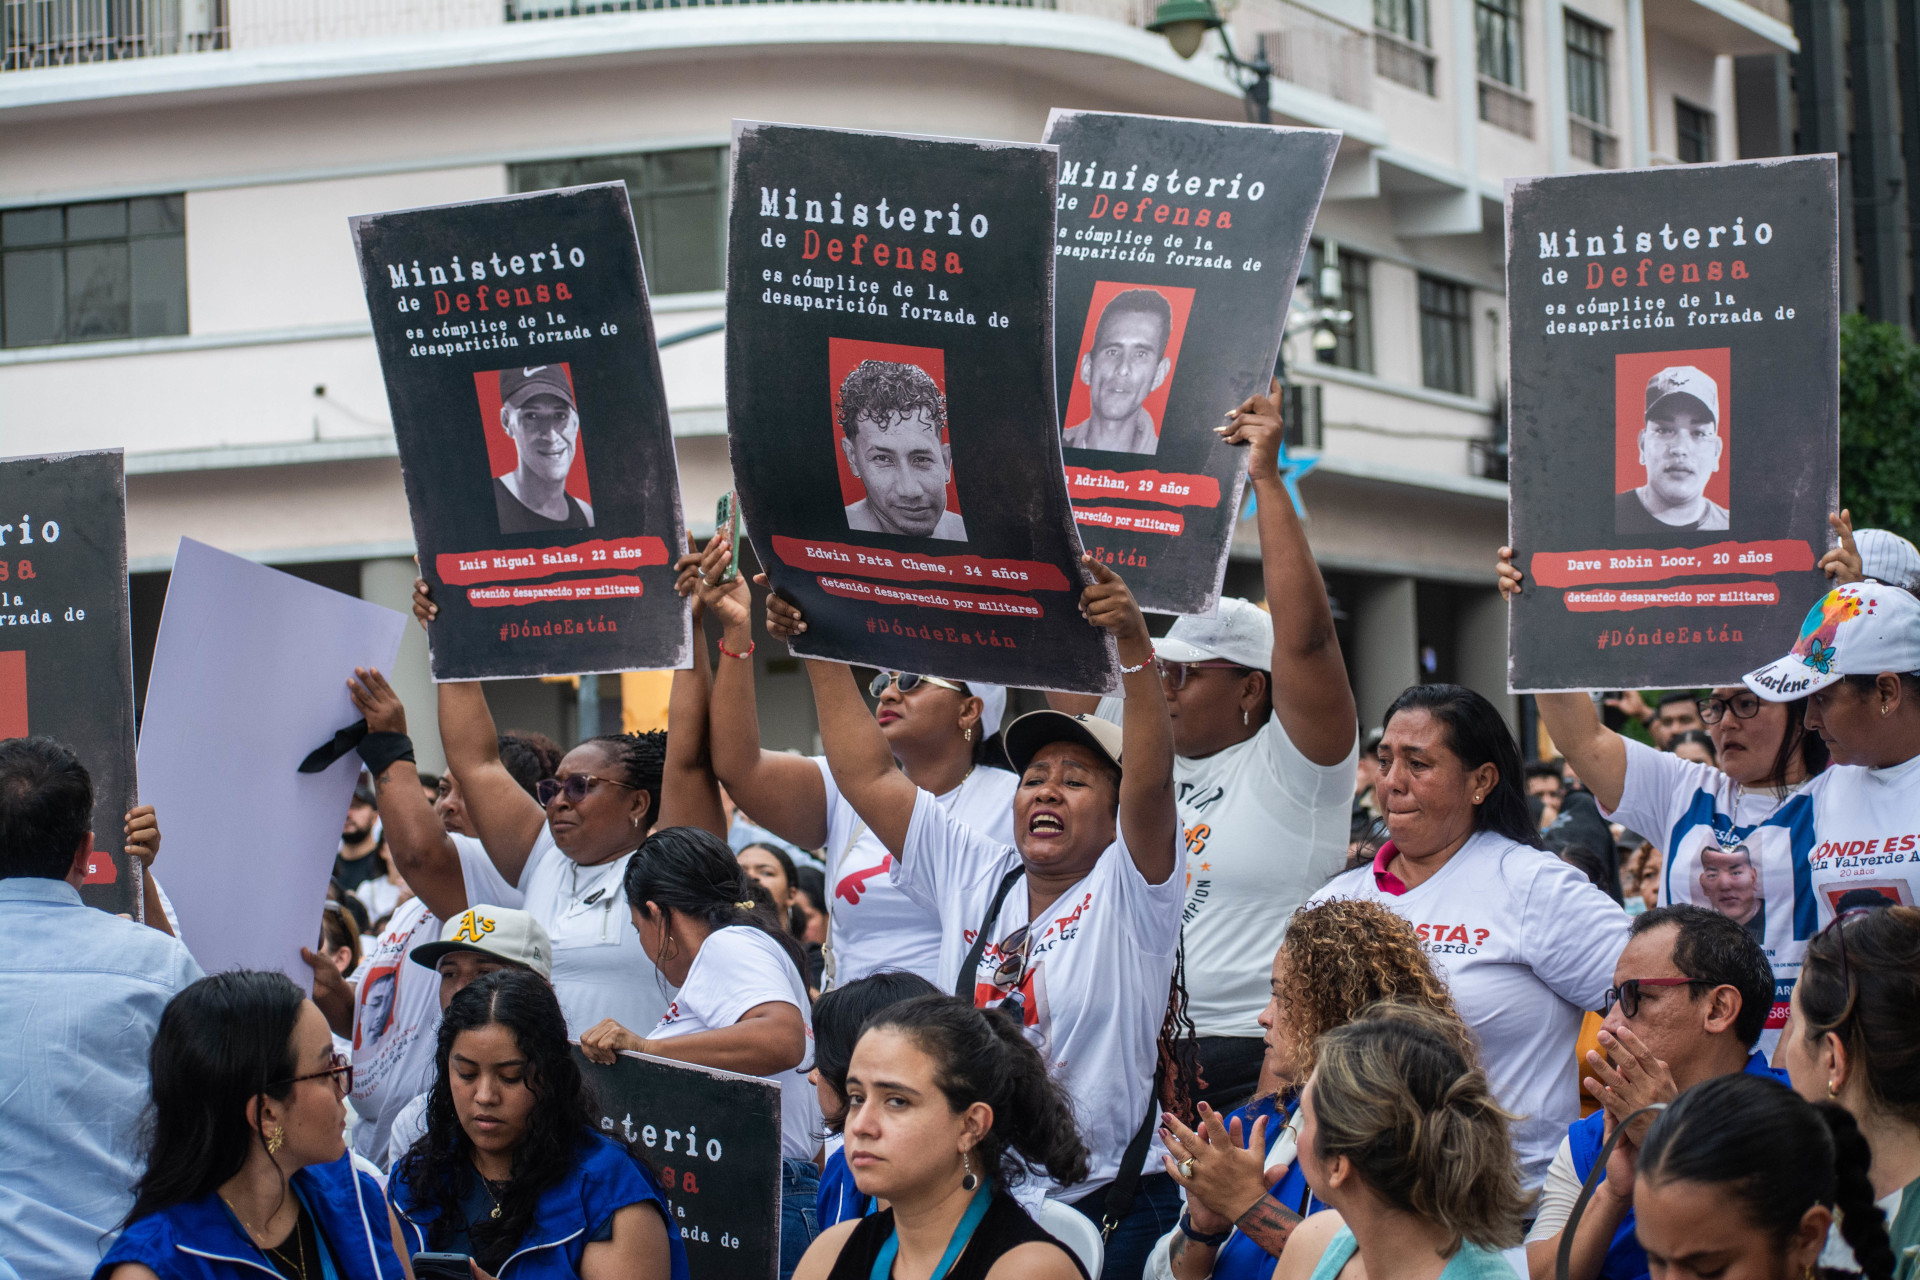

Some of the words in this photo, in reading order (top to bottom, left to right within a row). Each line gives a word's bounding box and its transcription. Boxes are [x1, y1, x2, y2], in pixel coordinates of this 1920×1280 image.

[1059, 160, 1265, 201] Ministerio
[760, 186, 988, 238] Ministerio
[1057, 193, 1078, 210] de
[1089, 194, 1233, 229] Defensa
[761, 228, 786, 248] de
[801, 230, 964, 274] Defensa
[1057, 226, 1067, 237] s
[1075, 225, 1153, 246] cómplice
[1164, 234, 1183, 248] de
[1194, 237, 1213, 251] la
[1539, 217, 1773, 259] Ministerio
[387, 243, 586, 289] Ministerio
[1055, 244, 1156, 263] esaparición
[1166, 252, 1233, 269] forzada
[1243, 258, 1262, 271] de
[762, 268, 783, 282] es
[792, 269, 880, 294] cómplice
[893, 281, 914, 297] de
[928, 284, 949, 301] la
[1542, 267, 1569, 285] de
[1586, 259, 1750, 290] Defensa
[397, 296, 421, 313] de
[433, 282, 573, 315] Defensa
[762, 288, 889, 316] desaparición
[901, 302, 977, 325] forzada
[988, 312, 1010, 328] de
[1545, 304, 1566, 315] es
[1576, 297, 1666, 316] cómplice
[1679, 293, 1700, 309] de
[1715, 291, 1736, 305] la
[405, 327, 424, 339] es
[432, 319, 508, 339] cómplice
[518, 315, 536, 329] de
[547, 312, 566, 325] la
[1546, 311, 1675, 335] desaparición
[1687, 308, 1763, 327] forzada
[1775, 306, 1796, 320] de
[409, 330, 519, 358] desaparición
[528, 326, 591, 345] forzada
[600, 322, 618, 336] de
[1075, 474, 1130, 492] Adrihan,
[1138, 480, 1153, 492] 29
[1160, 483, 1190, 496] años
[1074, 510, 1113, 524] parecido
[1115, 516, 1131, 527] por
[1134, 518, 1180, 533] militares
[459, 558, 487, 571] Luis
[493, 554, 536, 570] Miguel
[542, 551, 584, 565] Salas,
[592, 550, 606, 561] 22
[613, 547, 642, 560] años
[805, 547, 850, 563] Edwin
[857, 553, 894, 568] Pata
[901, 559, 953, 576] Cheme,
[964, 565, 983, 577] 34
[991, 568, 1028, 581] años
[1567, 559, 1601, 572] Dave
[1609, 557, 1653, 570] Robin
[1660, 555, 1702, 568] Loor,
[1713, 553, 1730, 565] 20
[1738, 551, 1773, 564] años
[470, 588, 510, 600] detenido
[513, 587, 573, 600] desaparecido
[575, 587, 591, 598] por
[594, 584, 640, 595] militares
[821, 577, 871, 594] detenido
[874, 586, 949, 606] desaparecido
[953, 598, 973, 610] por
[978, 600, 1038, 615] militares
[1567, 592, 1616, 603] detenido
[1620, 592, 1692, 604] desaparecido
[1696, 593, 1716, 604] por
[1719, 591, 1775, 602] militares
[0, 609, 52, 626] rzada
[64, 607, 85, 621] de
[500, 615, 618, 642] #DóndeEstán
[865, 617, 1017, 649] #DóndeEstán
[1597, 624, 1743, 649] #DóndeEstán
[1752, 665, 1810, 694] Marlene
[1835, 852, 1904, 868] Valverde
[1840, 869, 1851, 877] 20
[1854, 868, 1875, 876] años
[1182, 880, 1211, 923] MPION
[450, 910, 495, 942] A's
[1415, 923, 1490, 946] STÁ?
[721, 1232, 740, 1249] de
